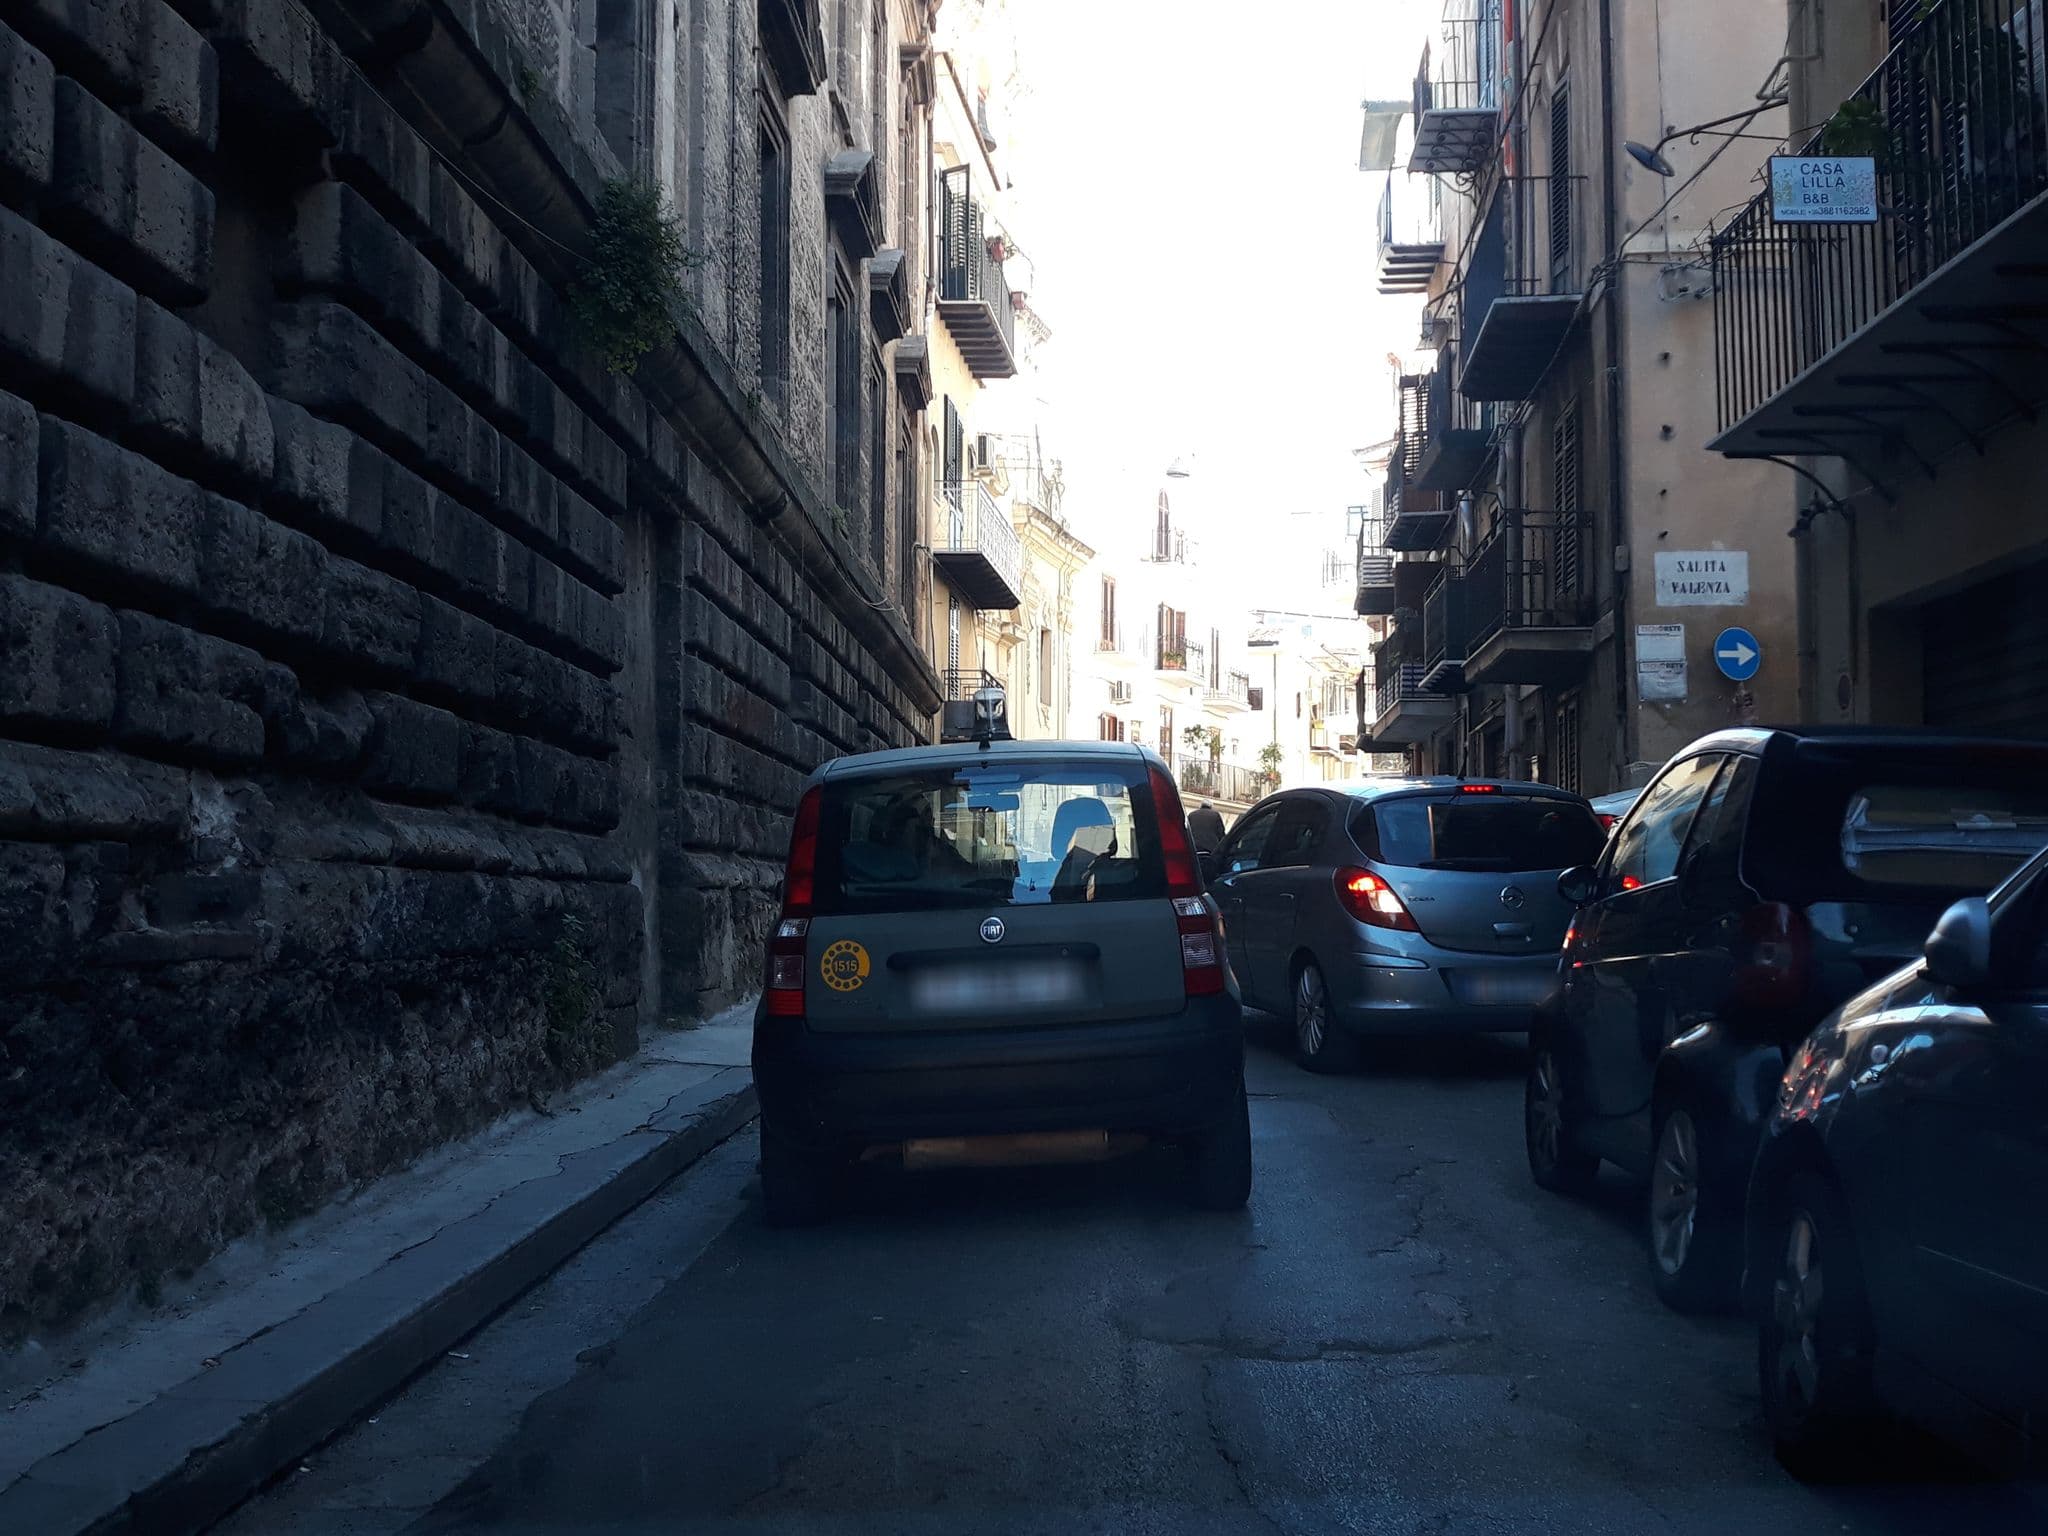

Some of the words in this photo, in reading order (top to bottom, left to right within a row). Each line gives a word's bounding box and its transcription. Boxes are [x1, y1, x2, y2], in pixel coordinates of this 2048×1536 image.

[1800, 163, 1844, 175] CASA
[1802, 176, 1846, 188] LILLA
[1803, 193, 1829, 204] B&B
[1677, 560, 1726, 572] SALITA
[1671, 581, 1730, 594] VALENZA
[983, 925, 1000, 935] FIAT
[834, 960, 858, 972] 1515
